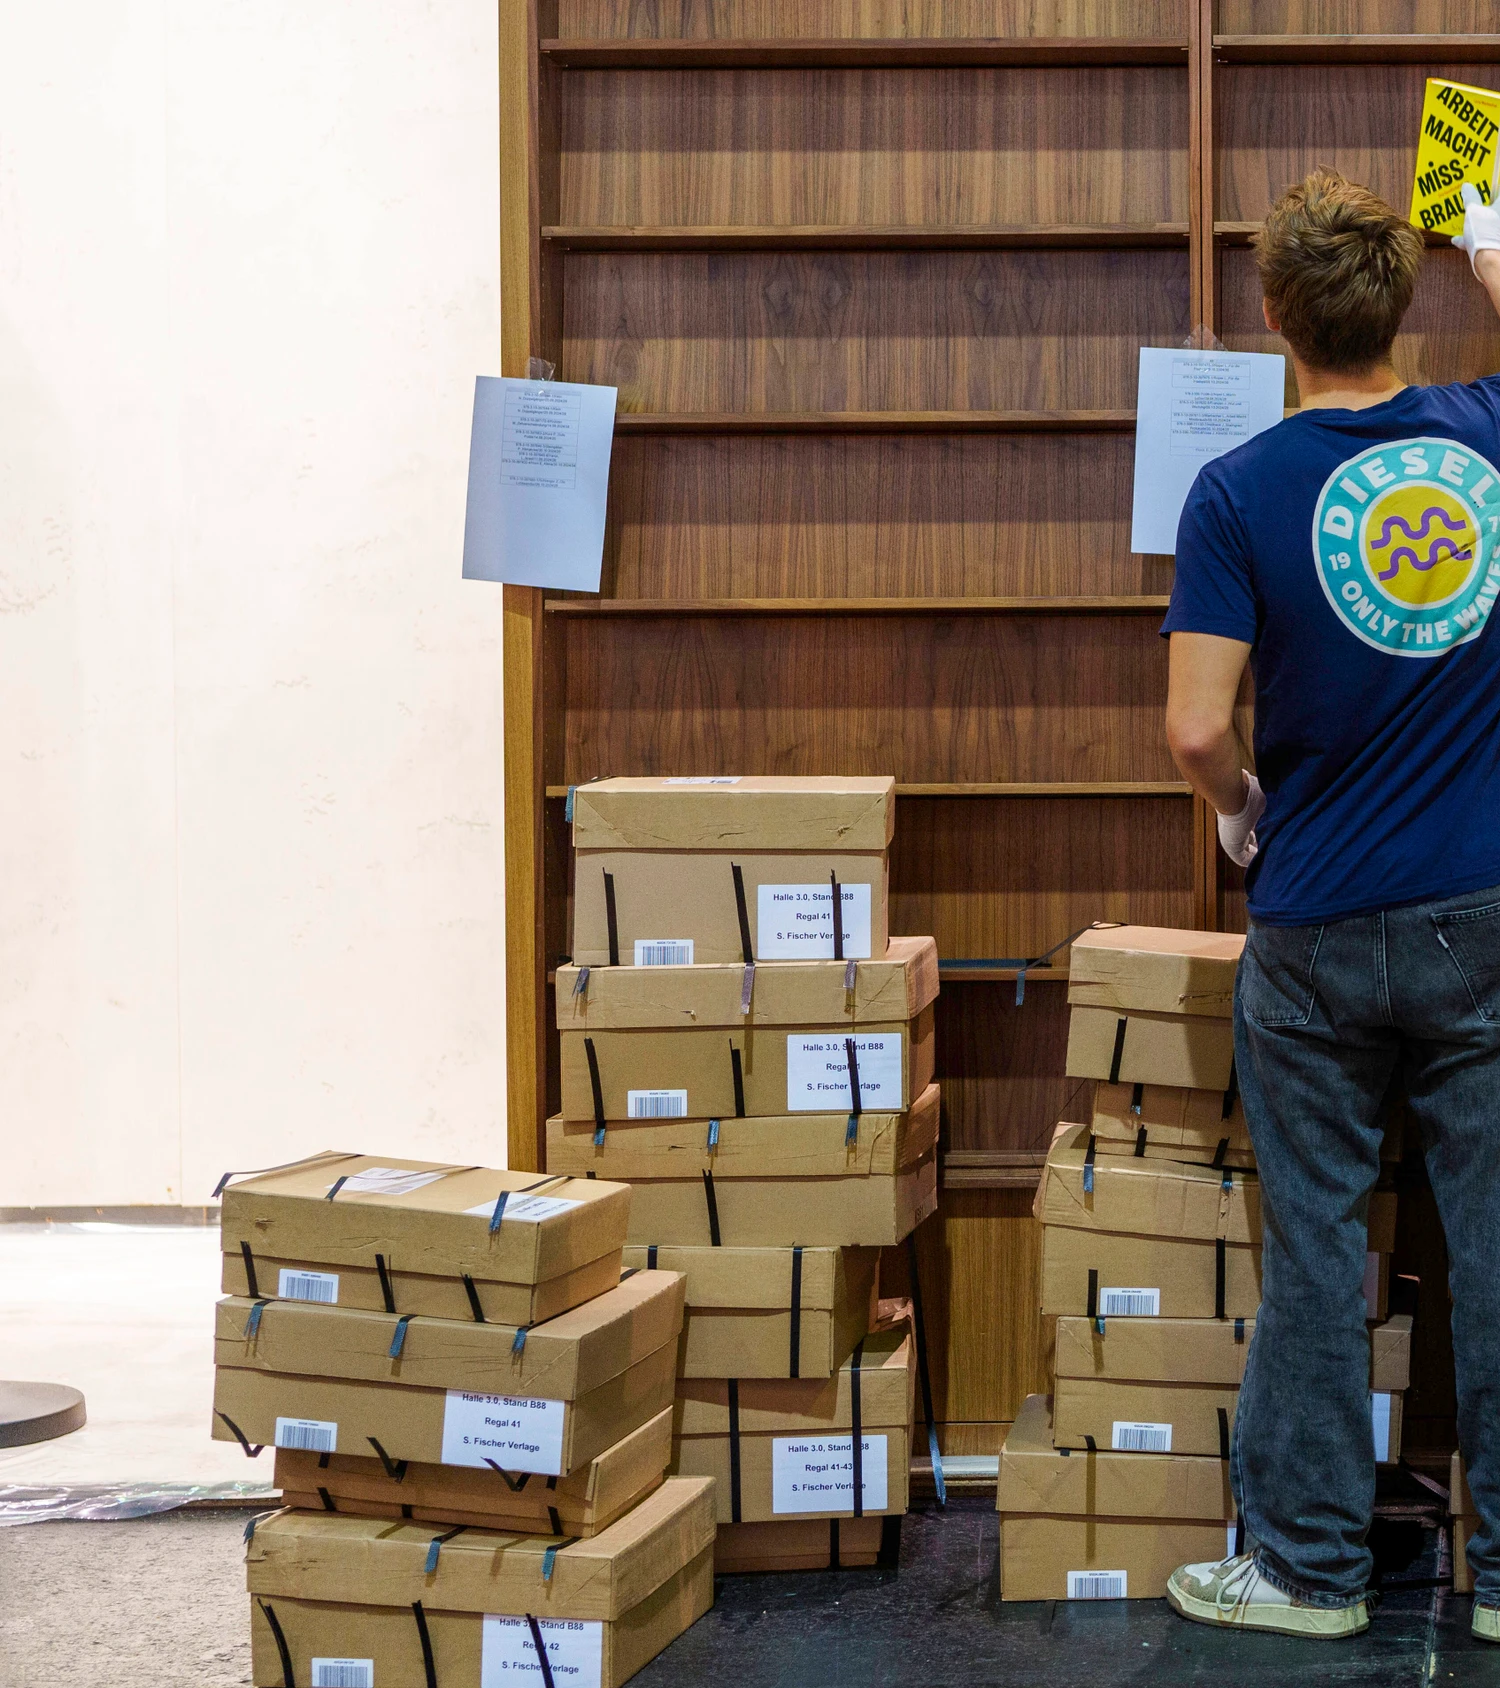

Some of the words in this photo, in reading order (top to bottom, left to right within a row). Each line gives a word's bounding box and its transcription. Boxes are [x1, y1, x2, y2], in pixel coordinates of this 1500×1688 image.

[1436, 86, 1499, 143] ARBEIT
[1425, 114, 1491, 167] MACHT
[1419, 179, 1491, 229] BRAUH
[1323, 447, 1494, 540] DIESEL
[1328, 552, 1351, 571] 19
[1341, 580, 1399, 637] ONLY
[1402, 621, 1452, 644] THE
[796, 913, 819, 921] Regal
[820, 932, 850, 940] Verge
[850, 1083, 880, 1091] rlage
[462, 1393, 483, 1403] Halle
[486, 1396, 500, 1405] 3.0,
[503, 1398, 527, 1407] Stand
[530, 1401, 546, 1410] B88
[485, 1417, 508, 1428] Regal
[463, 1436, 471, 1444] S.
[474, 1437, 505, 1447] Fischer
[508, 1442, 540, 1452] Verlage
[806, 1464, 828, 1472] Regal
[500, 1619, 520, 1627] Halle
[541, 1621, 564, 1629] Stand
[568, 1622, 584, 1630] B88
[513, 1662, 543, 1670] Fische
